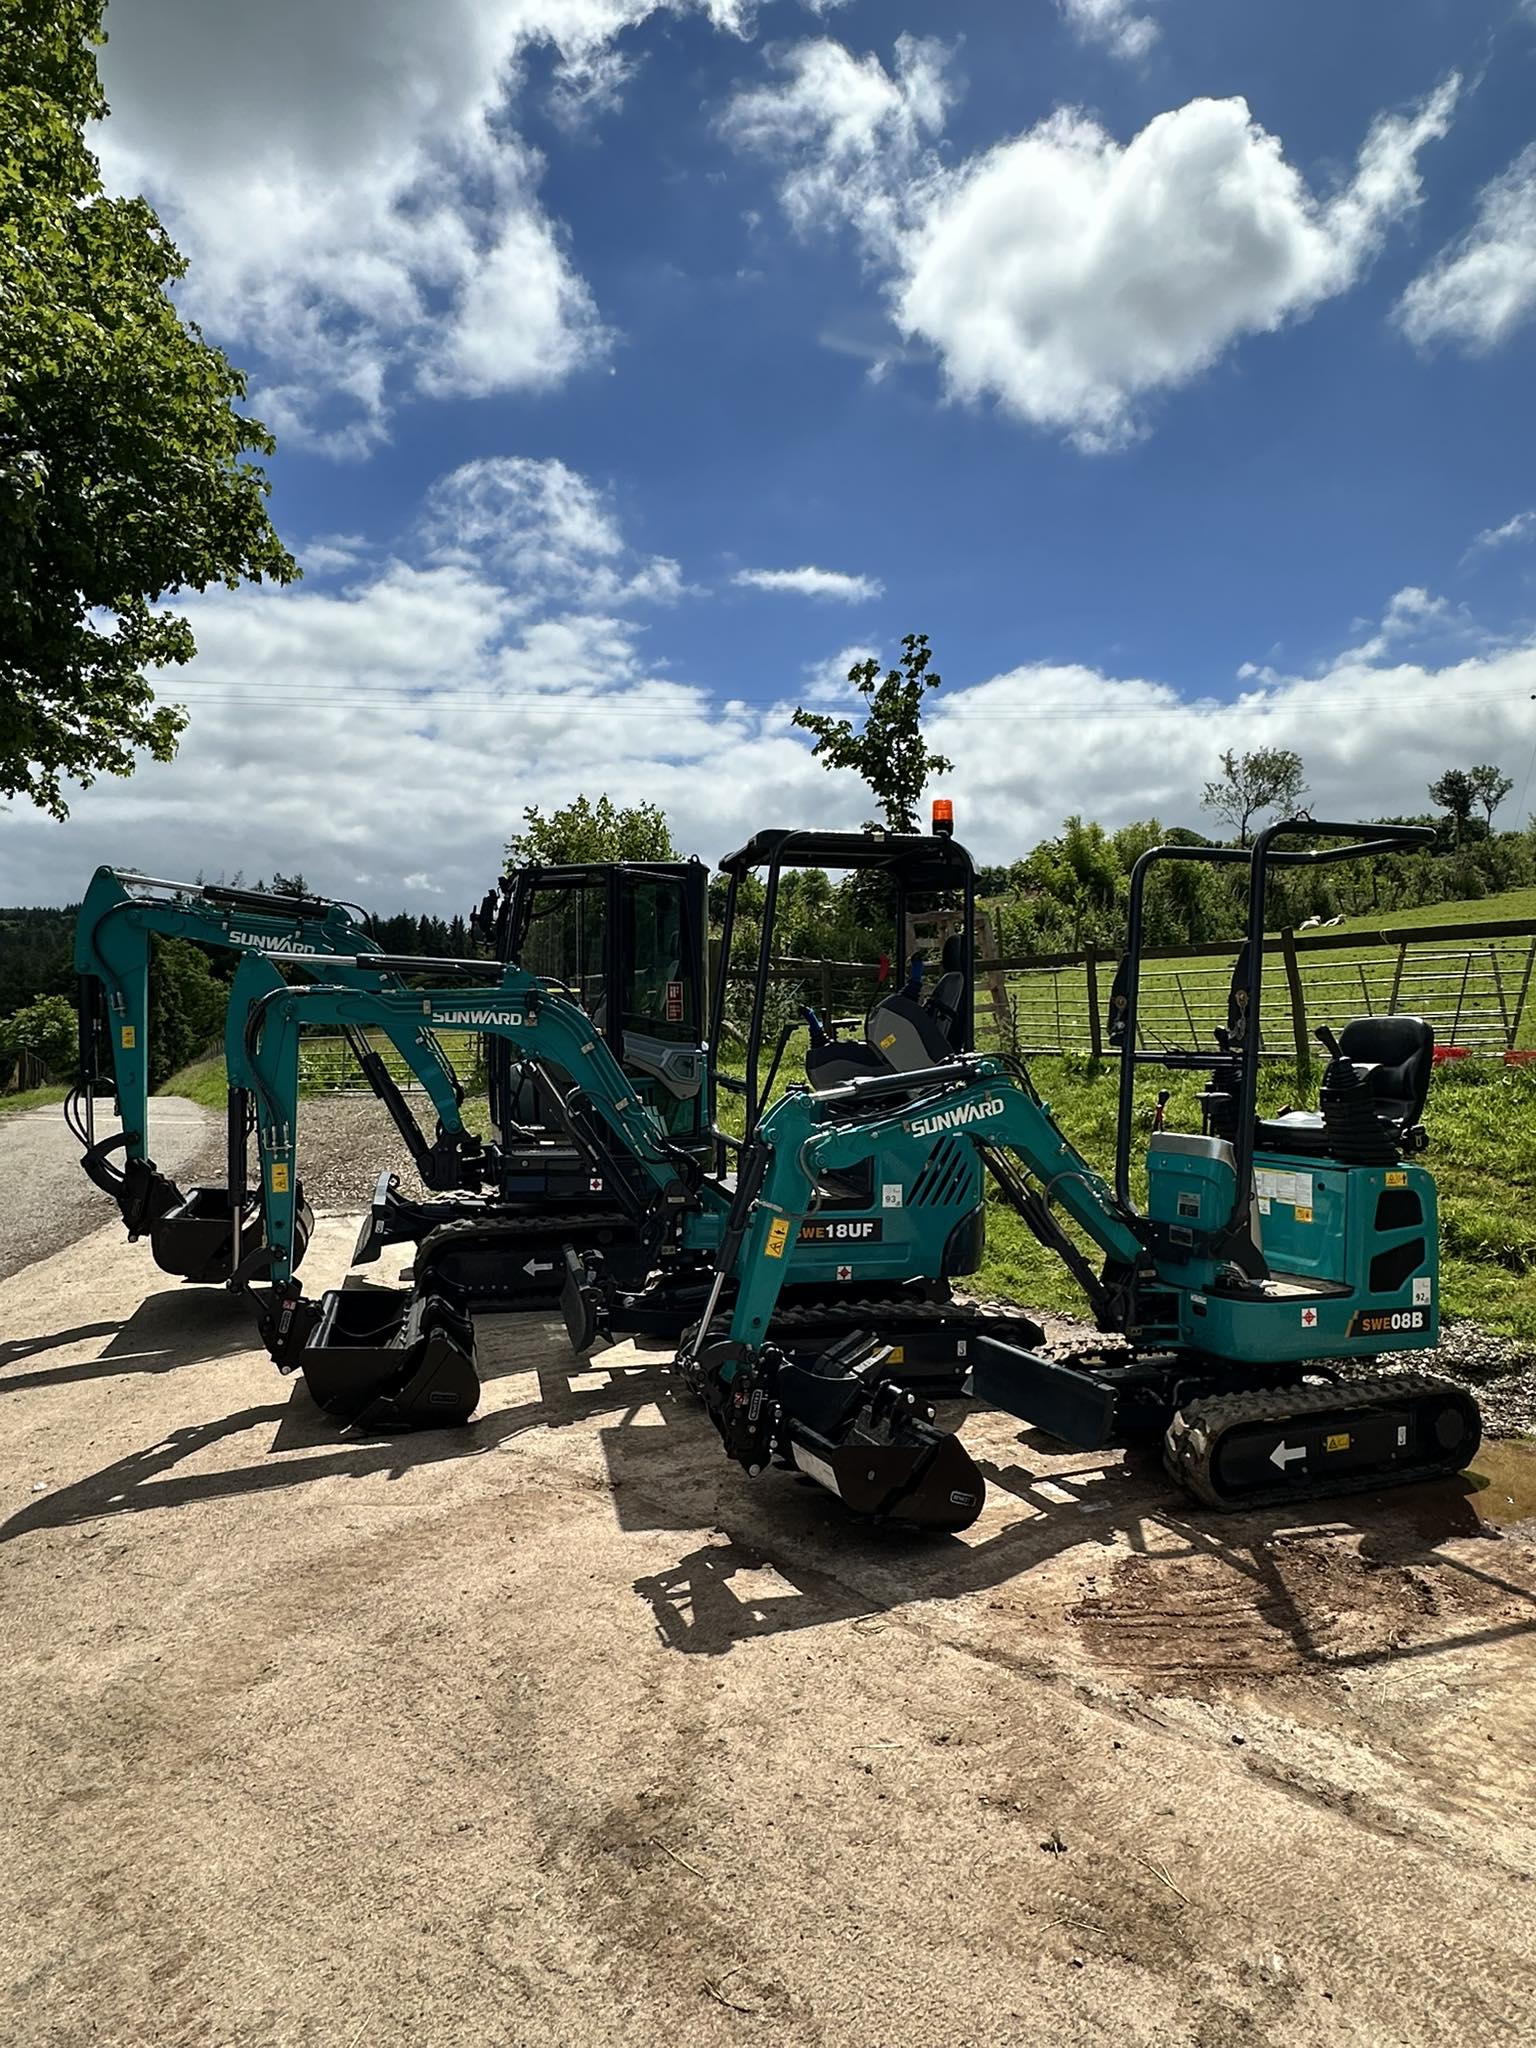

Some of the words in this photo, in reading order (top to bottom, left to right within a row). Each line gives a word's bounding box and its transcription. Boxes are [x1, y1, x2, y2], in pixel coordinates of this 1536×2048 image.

[228, 930, 316, 954] SUNWARD
[432, 1010, 522, 1026] SUNWARD
[911, 1098, 1005, 1138] SUNWARD
[1362, 1311, 1424, 1332] SWE08B
